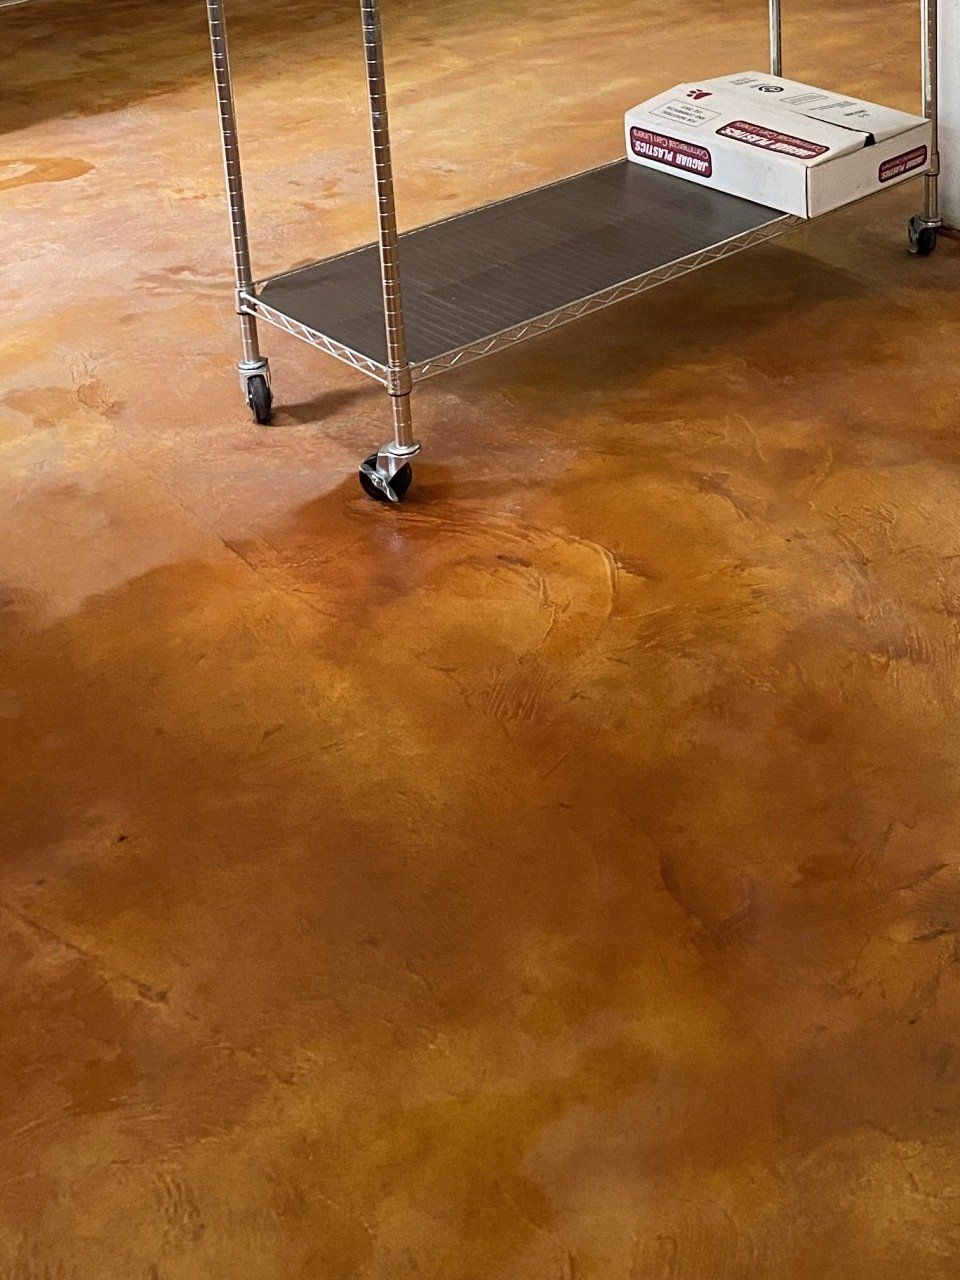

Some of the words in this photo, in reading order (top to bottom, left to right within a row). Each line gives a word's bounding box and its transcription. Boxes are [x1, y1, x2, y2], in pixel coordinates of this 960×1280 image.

[633, 129, 652, 143] Liners
[654, 135, 668, 147] Can
[635, 140, 673, 161] PLASTICS
[669, 140, 708, 160] Commercial
[675, 153, 708, 171] JAGUAR
